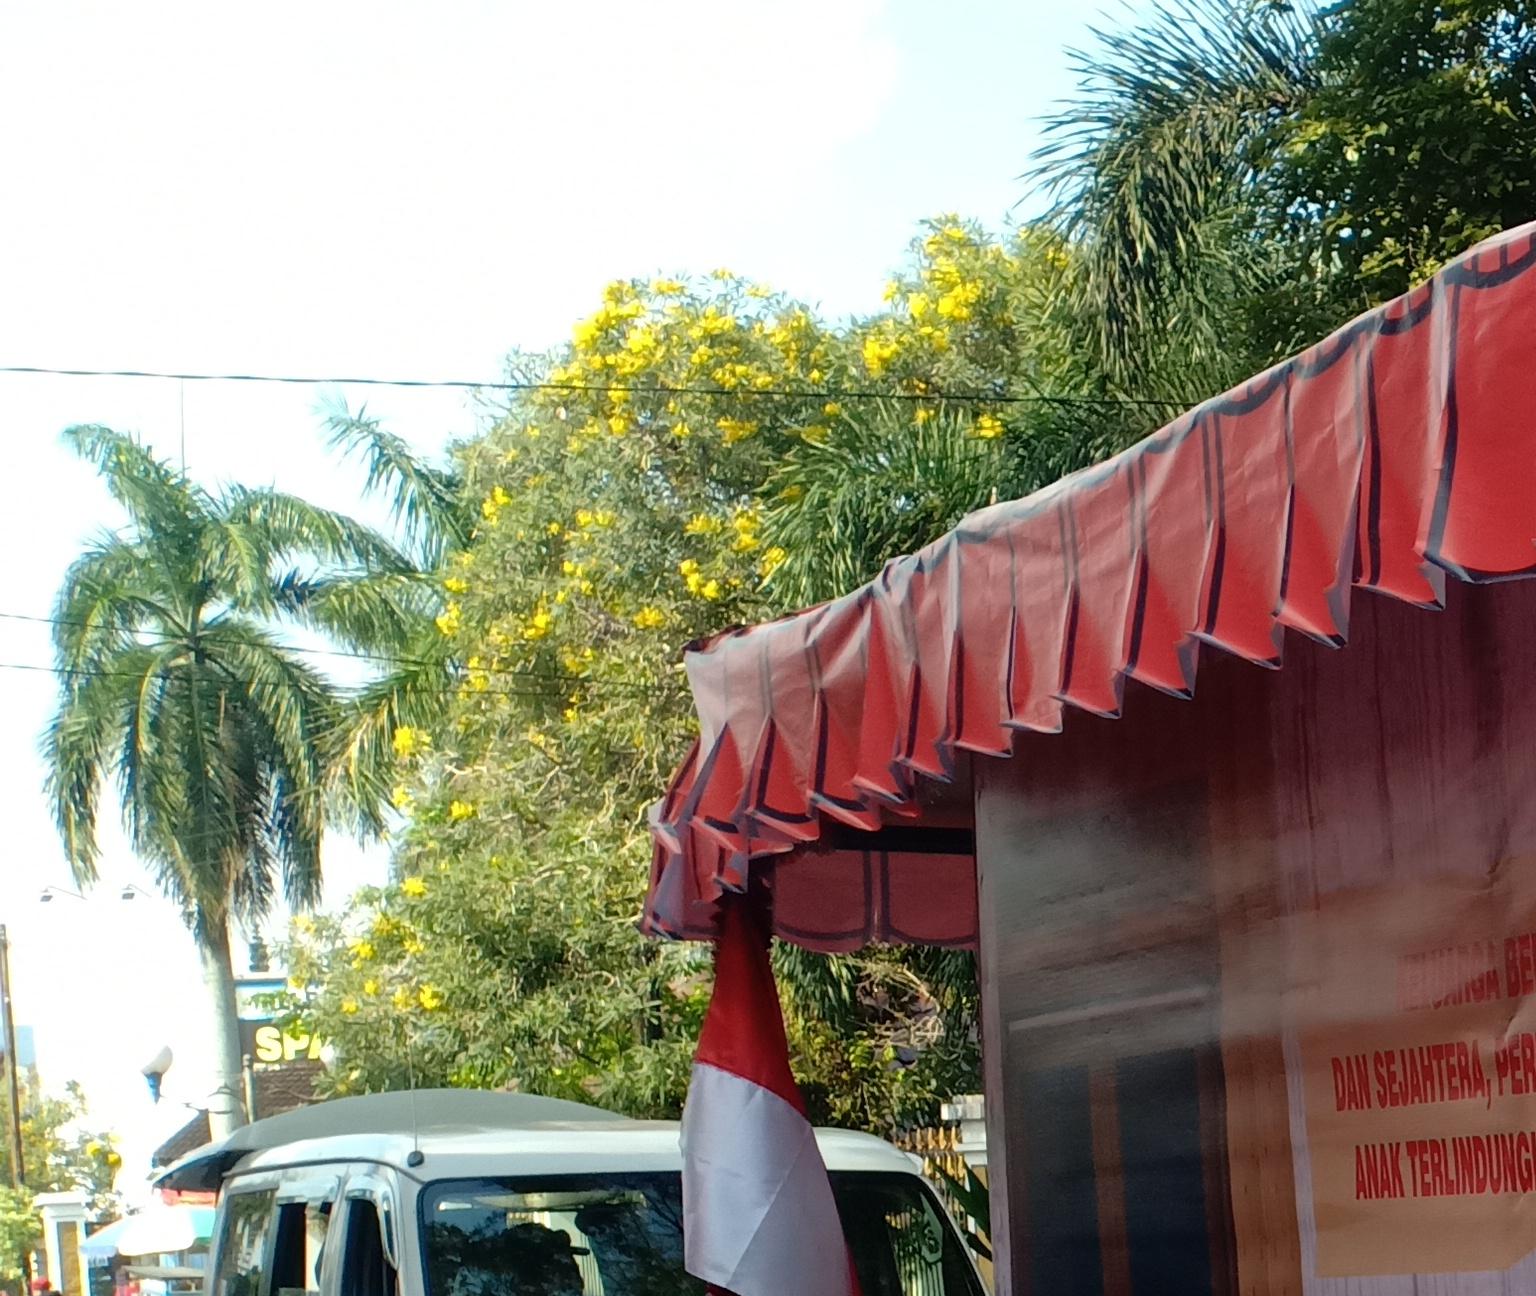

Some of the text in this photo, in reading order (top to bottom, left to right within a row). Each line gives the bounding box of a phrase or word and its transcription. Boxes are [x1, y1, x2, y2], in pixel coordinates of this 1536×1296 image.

[1331, 1055, 1372, 1112] DAN
[1373, 1038, 1492, 1110] SEJAHTERA,
[1354, 1141, 1403, 1200] ANAK
